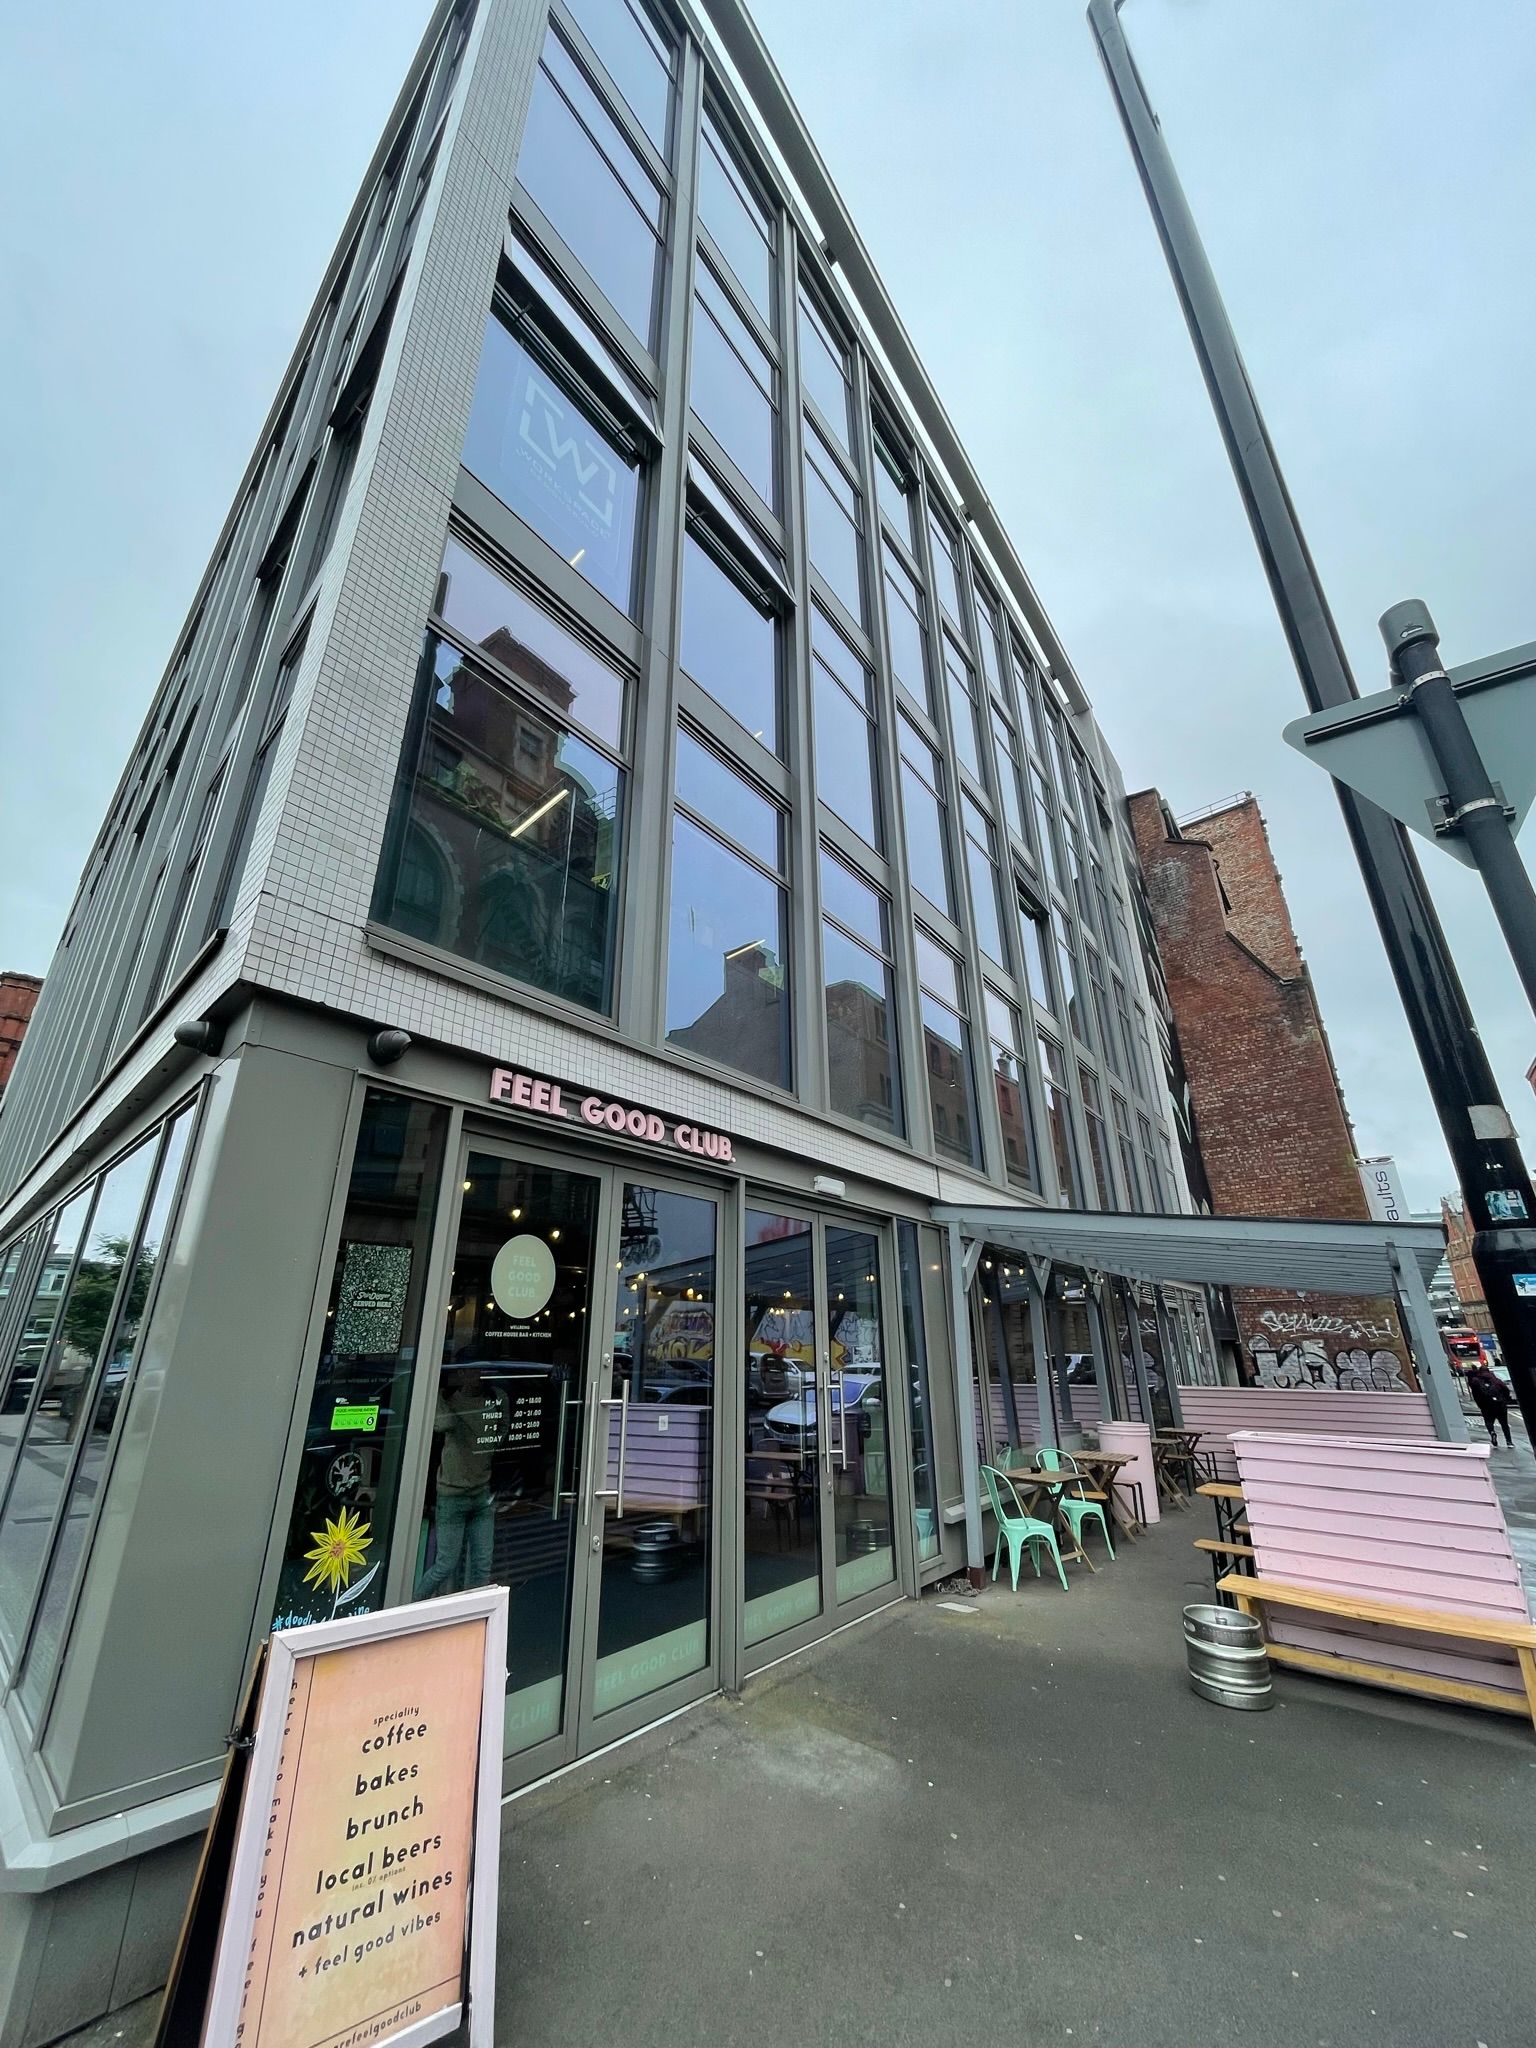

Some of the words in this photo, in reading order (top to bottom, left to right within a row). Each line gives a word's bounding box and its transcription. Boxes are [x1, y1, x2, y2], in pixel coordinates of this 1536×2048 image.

[489, 1067, 568, 1117] FEEL
[580, 1096, 666, 1144] GOOD
[513, 1255, 536, 1267] FEEL
[508, 1271, 541, 1283] GOOD
[508, 1287, 536, 1298] CLUB
[476, 1435, 502, 1444] SUNDAY
[630, 1652, 666, 1679] GOOD
[284, 1678, 298, 1736] here
[373, 1706, 420, 1728] speciality
[362, 1723, 427, 1753] coffee
[355, 1764, 419, 1796] bakes
[346, 1795, 424, 1840] brunch
[316, 1851, 374, 1894] local
[382, 1834, 442, 1869] beers
[379, 1866, 406, 1882] options
[255, 1874, 267, 1919] you
[292, 1889, 384, 1948] natural
[393, 1870, 453, 1906] wines
[298, 1965, 308, 1978] +
[315, 1945, 348, 1975] feel
[354, 1925, 395, 1963] good
[401, 1911, 441, 1937] vibes
